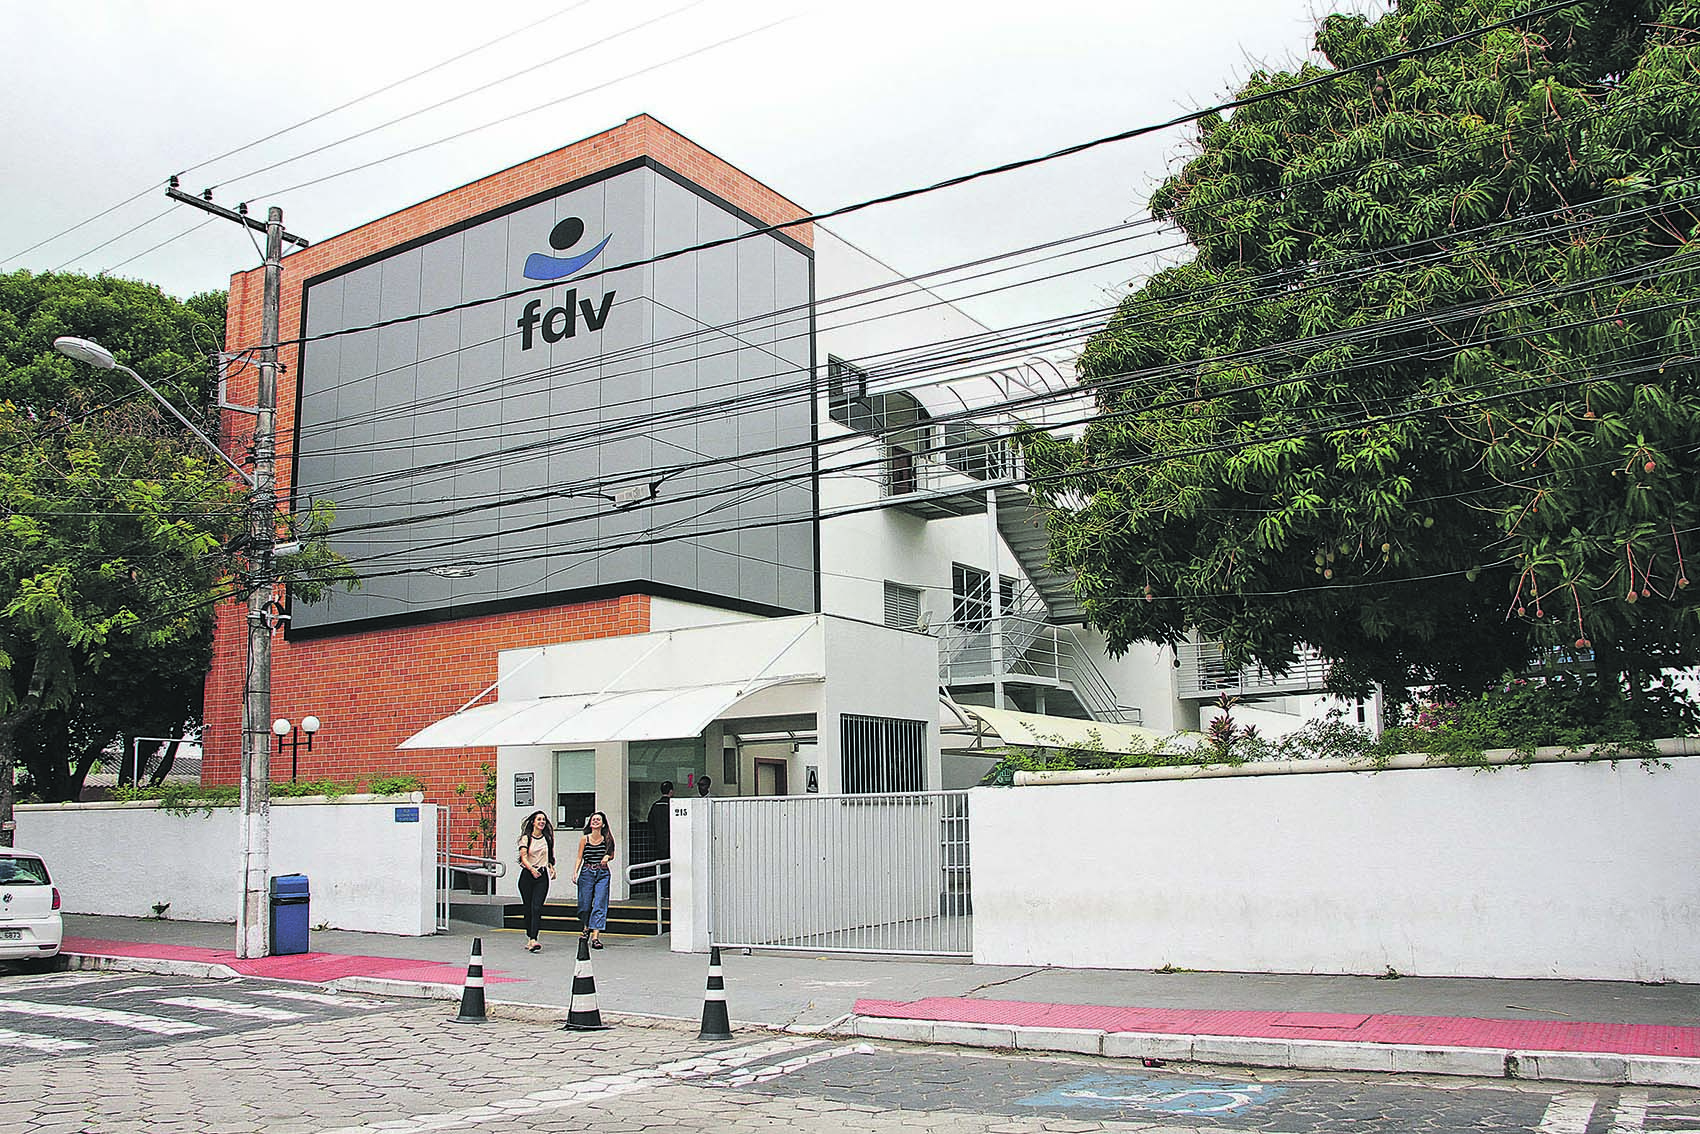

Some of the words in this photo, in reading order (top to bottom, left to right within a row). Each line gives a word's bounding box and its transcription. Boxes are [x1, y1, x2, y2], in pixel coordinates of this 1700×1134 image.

[517, 288, 616, 351] fdv
[808, 770, 818, 787] A
[675, 808, 687, 816] 215
